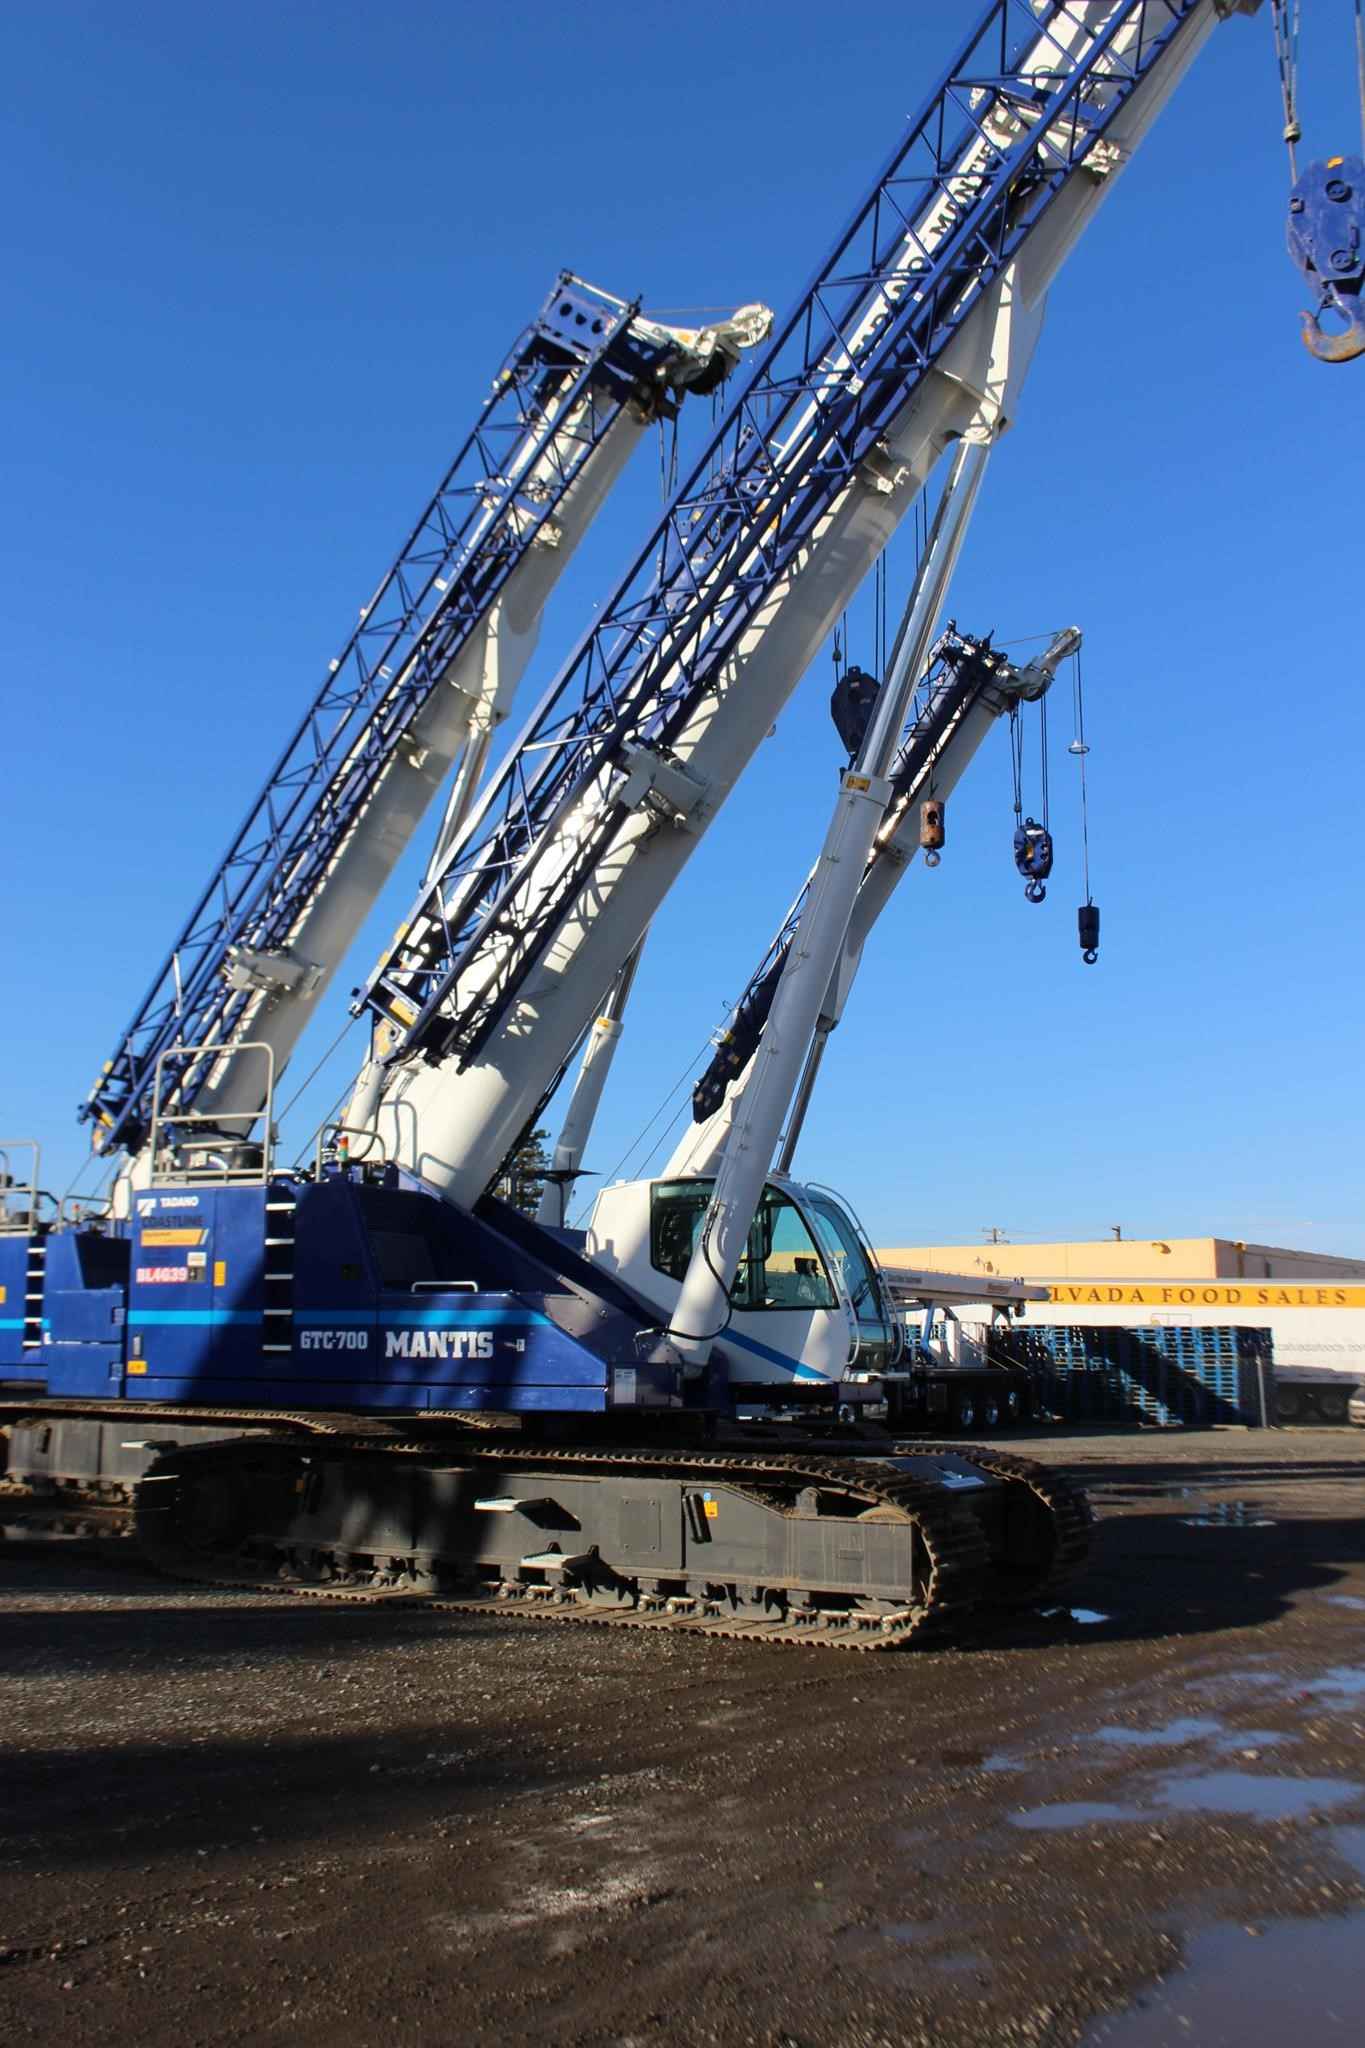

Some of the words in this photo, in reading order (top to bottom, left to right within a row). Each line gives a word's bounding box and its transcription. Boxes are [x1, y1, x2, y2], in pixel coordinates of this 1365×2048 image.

[1163, 1287, 1241, 1304] FOOD
[1258, 1288, 1347, 1305] SALES
[301, 1331, 368, 1349] GTC-700
[385, 1331, 494, 1358] MANTIS
